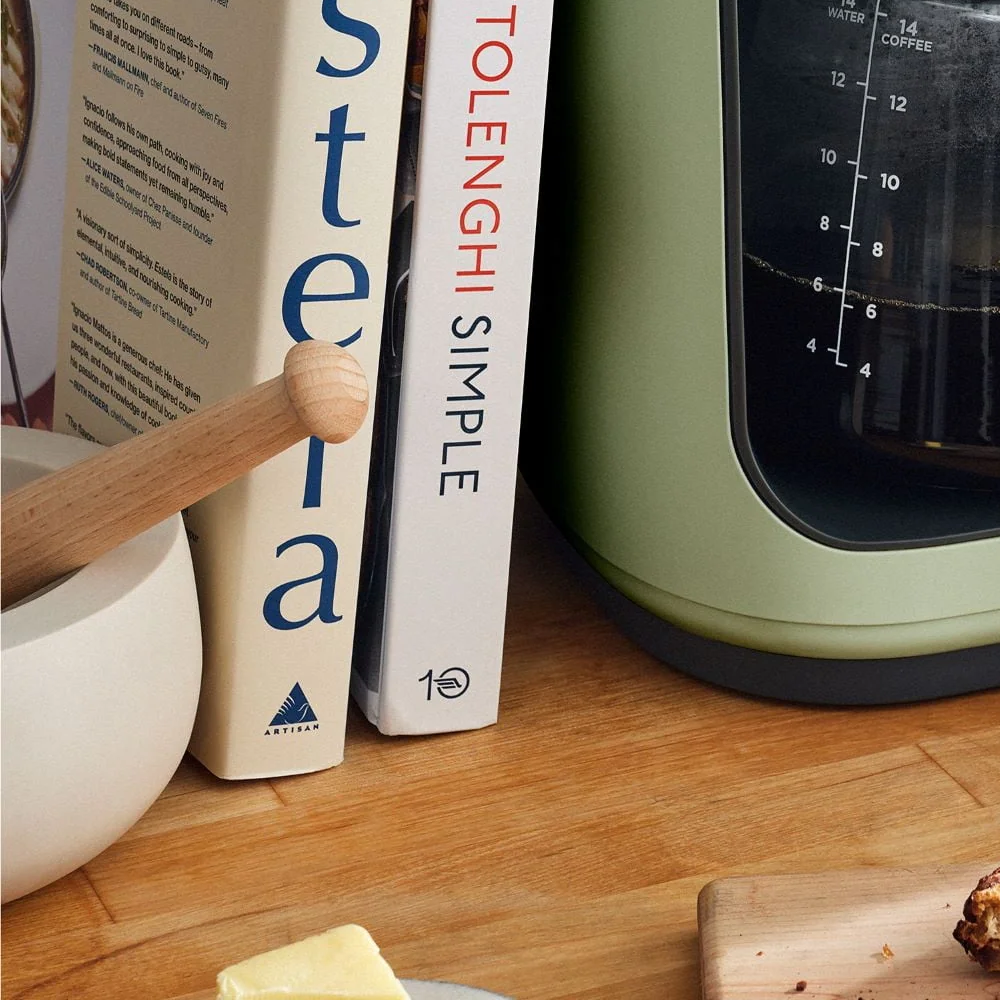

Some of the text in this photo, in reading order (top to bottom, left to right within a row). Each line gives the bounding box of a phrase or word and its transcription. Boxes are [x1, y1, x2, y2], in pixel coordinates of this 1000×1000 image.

[828, 6, 865, 24] WATER
[898, 19, 918, 38] 14
[881, 33, 934, 53] COFFEE
[831, 71, 846, 88] 12
[889, 95, 908, 112] 12
[820, 148, 837, 165] 10
[880, 173, 900, 191] 10
[820, 216, 830, 231] 8
[872, 242, 884, 258] 8
[813, 277, 824, 292] 6
[865, 304, 877, 319] 6
[806, 338, 817, 353] 4
[860, 363, 872, 379] 4
[439, 315, 492, 497] SIMPLE
[264, 723, 320, 736] ARTISAN
